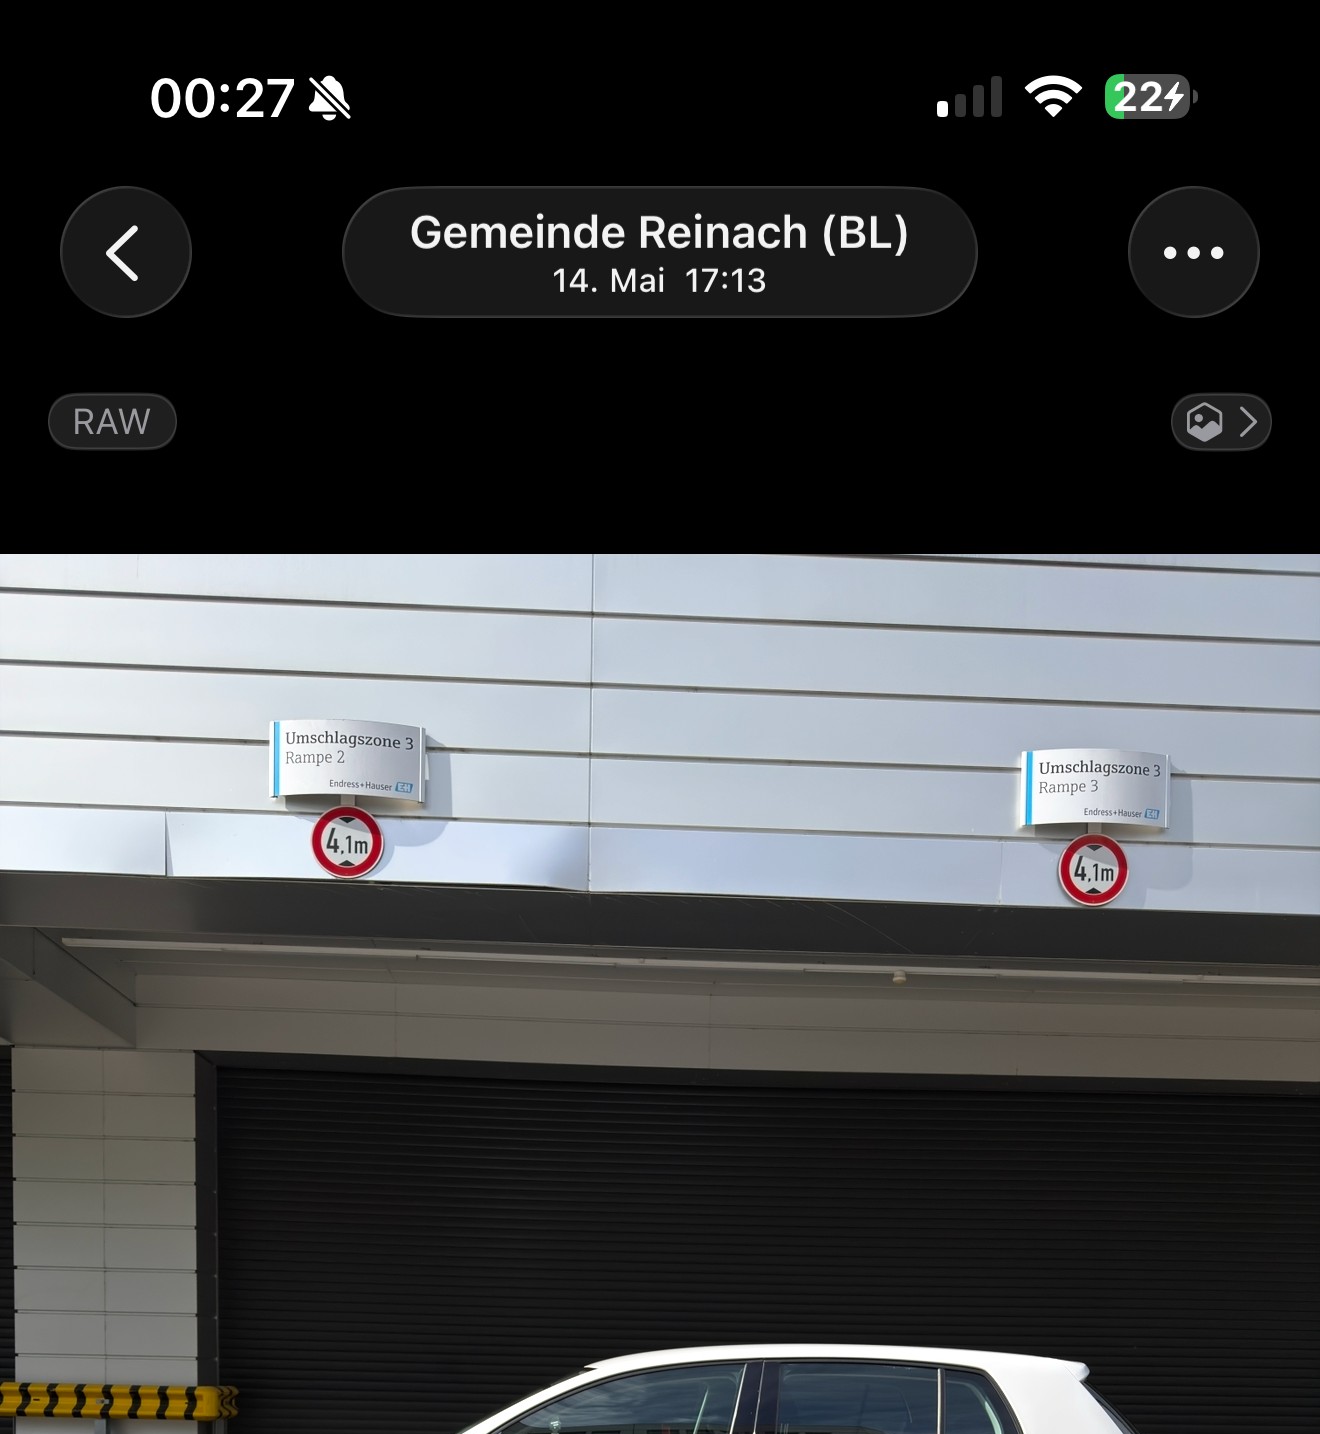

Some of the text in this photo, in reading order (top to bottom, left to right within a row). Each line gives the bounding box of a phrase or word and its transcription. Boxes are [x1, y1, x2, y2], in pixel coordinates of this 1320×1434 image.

[285, 731, 414, 750] Umschlagszone 3
[285, 750, 345, 766] Rampe 2
[1039, 760, 1161, 777] Umschlagszone 3
[329, 779, 393, 792] Endress+Hauser
[1039, 779, 1099, 795] Rampe 3
[1084, 808, 1142, 818] Endress+Hauser
